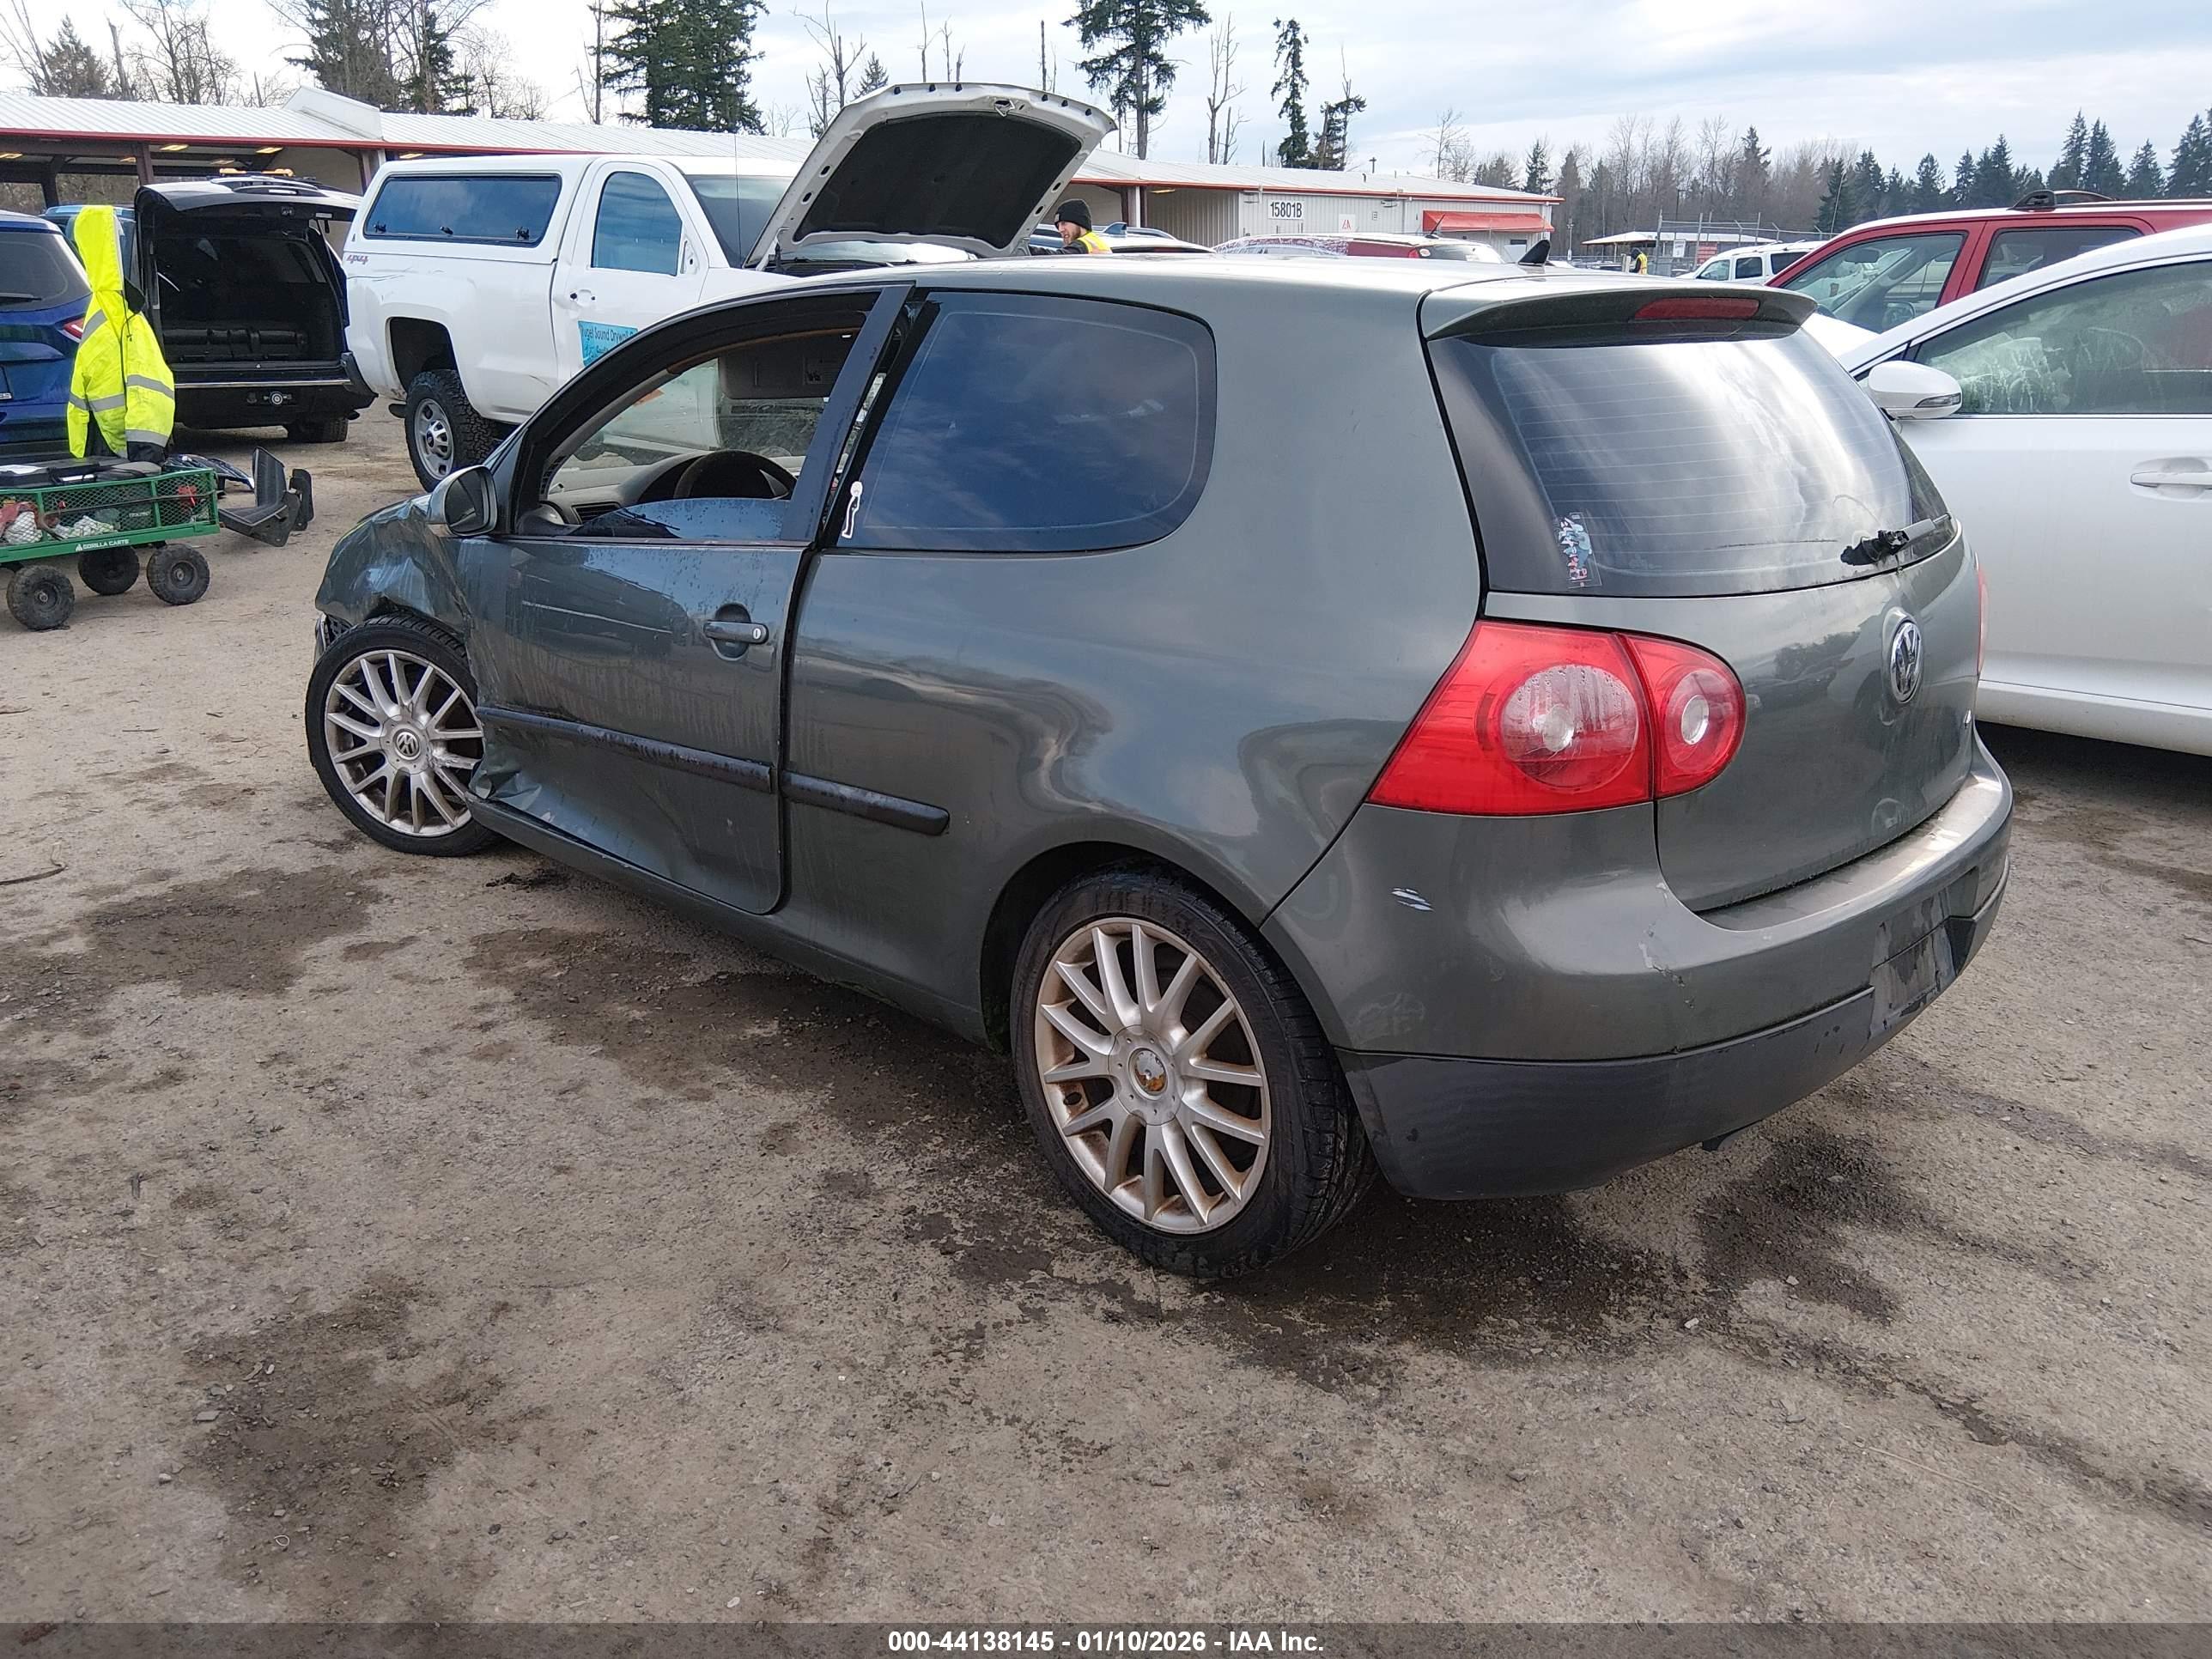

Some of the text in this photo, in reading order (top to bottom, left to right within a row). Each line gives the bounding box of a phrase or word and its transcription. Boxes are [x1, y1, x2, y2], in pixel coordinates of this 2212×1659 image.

[1270, 201, 1303, 218] 15801B
[595, 326, 610, 341] Sound
[82, 541, 108, 550] GORILLA
